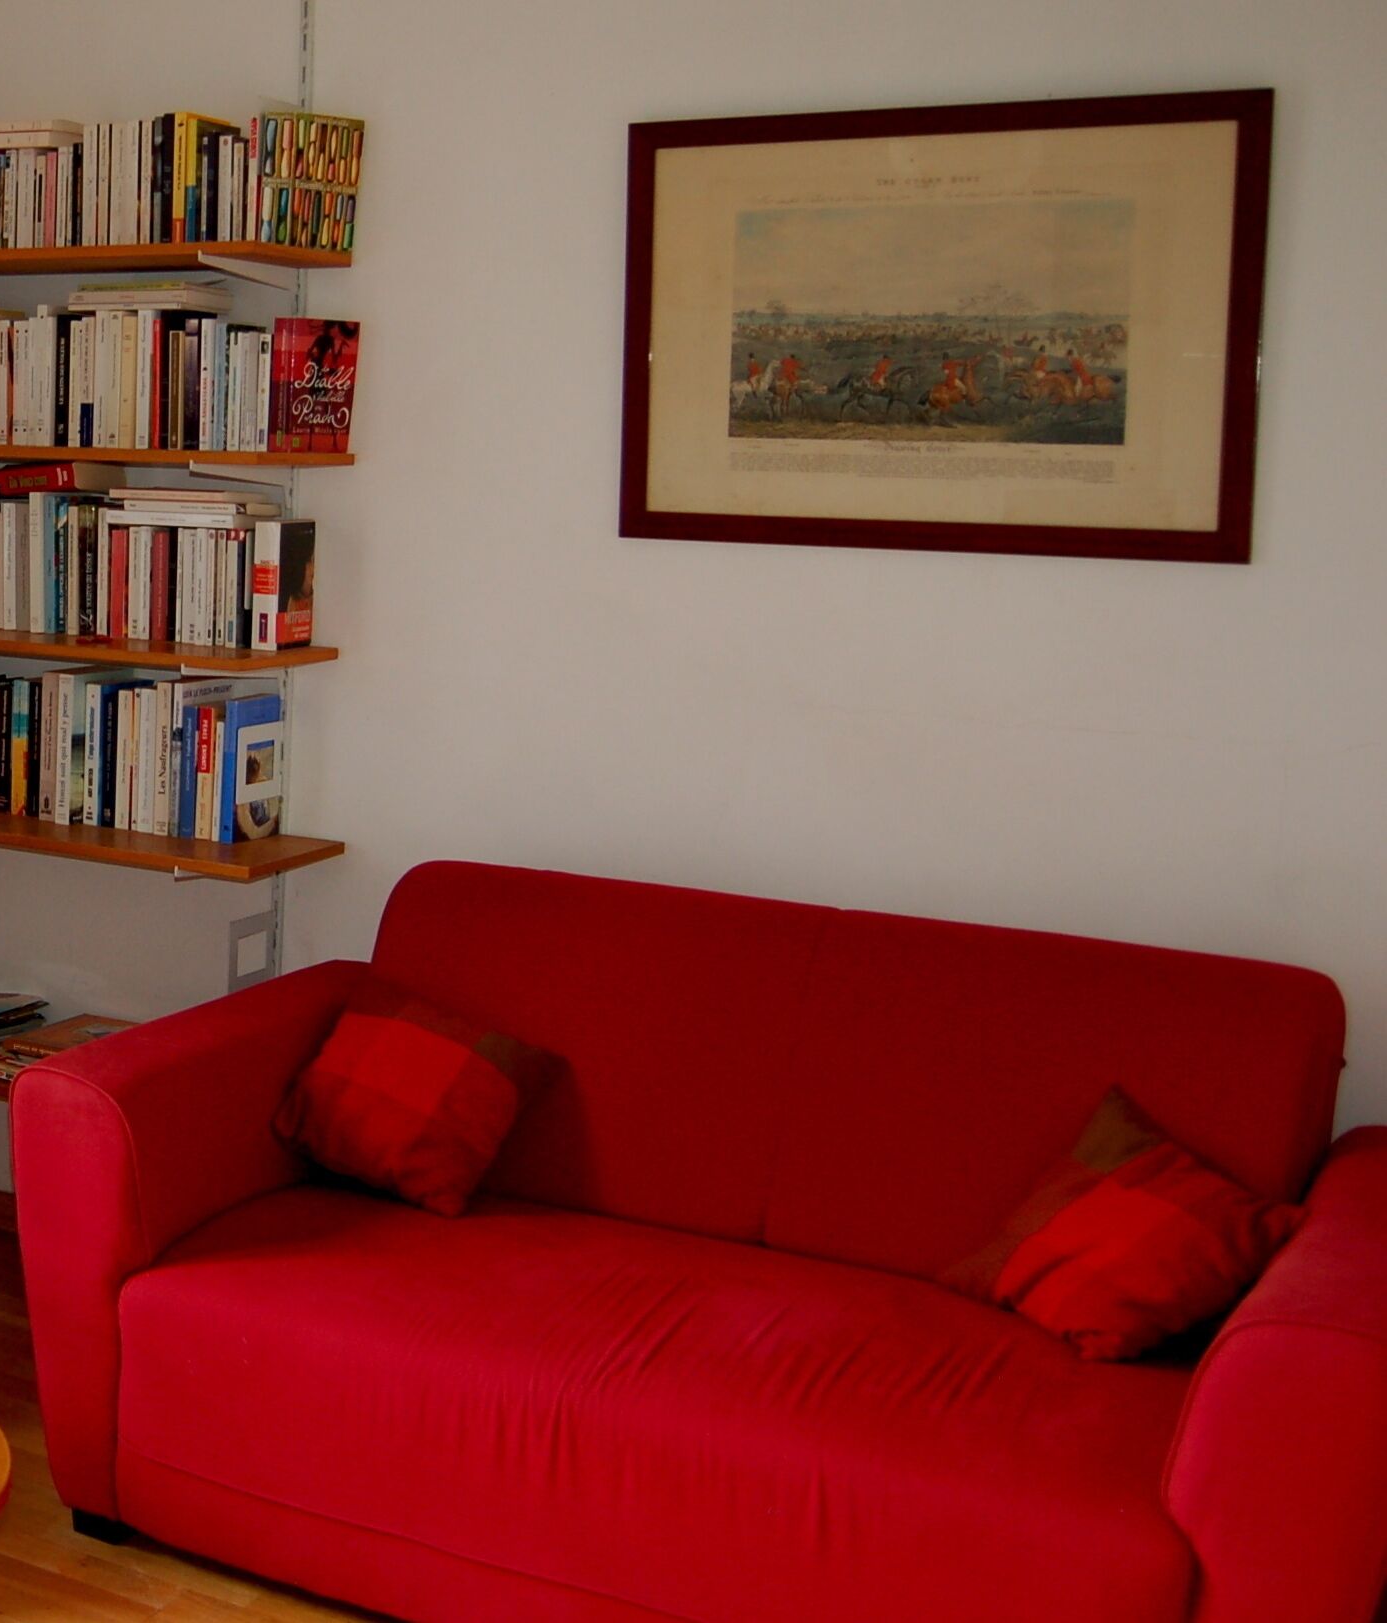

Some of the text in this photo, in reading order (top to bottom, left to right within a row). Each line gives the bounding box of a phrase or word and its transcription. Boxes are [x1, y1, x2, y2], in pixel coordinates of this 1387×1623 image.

[294, 361, 355, 391] Diable
[292, 394, 350, 429] Prada
[158, 725, 168, 796] Les Naufrageurs
